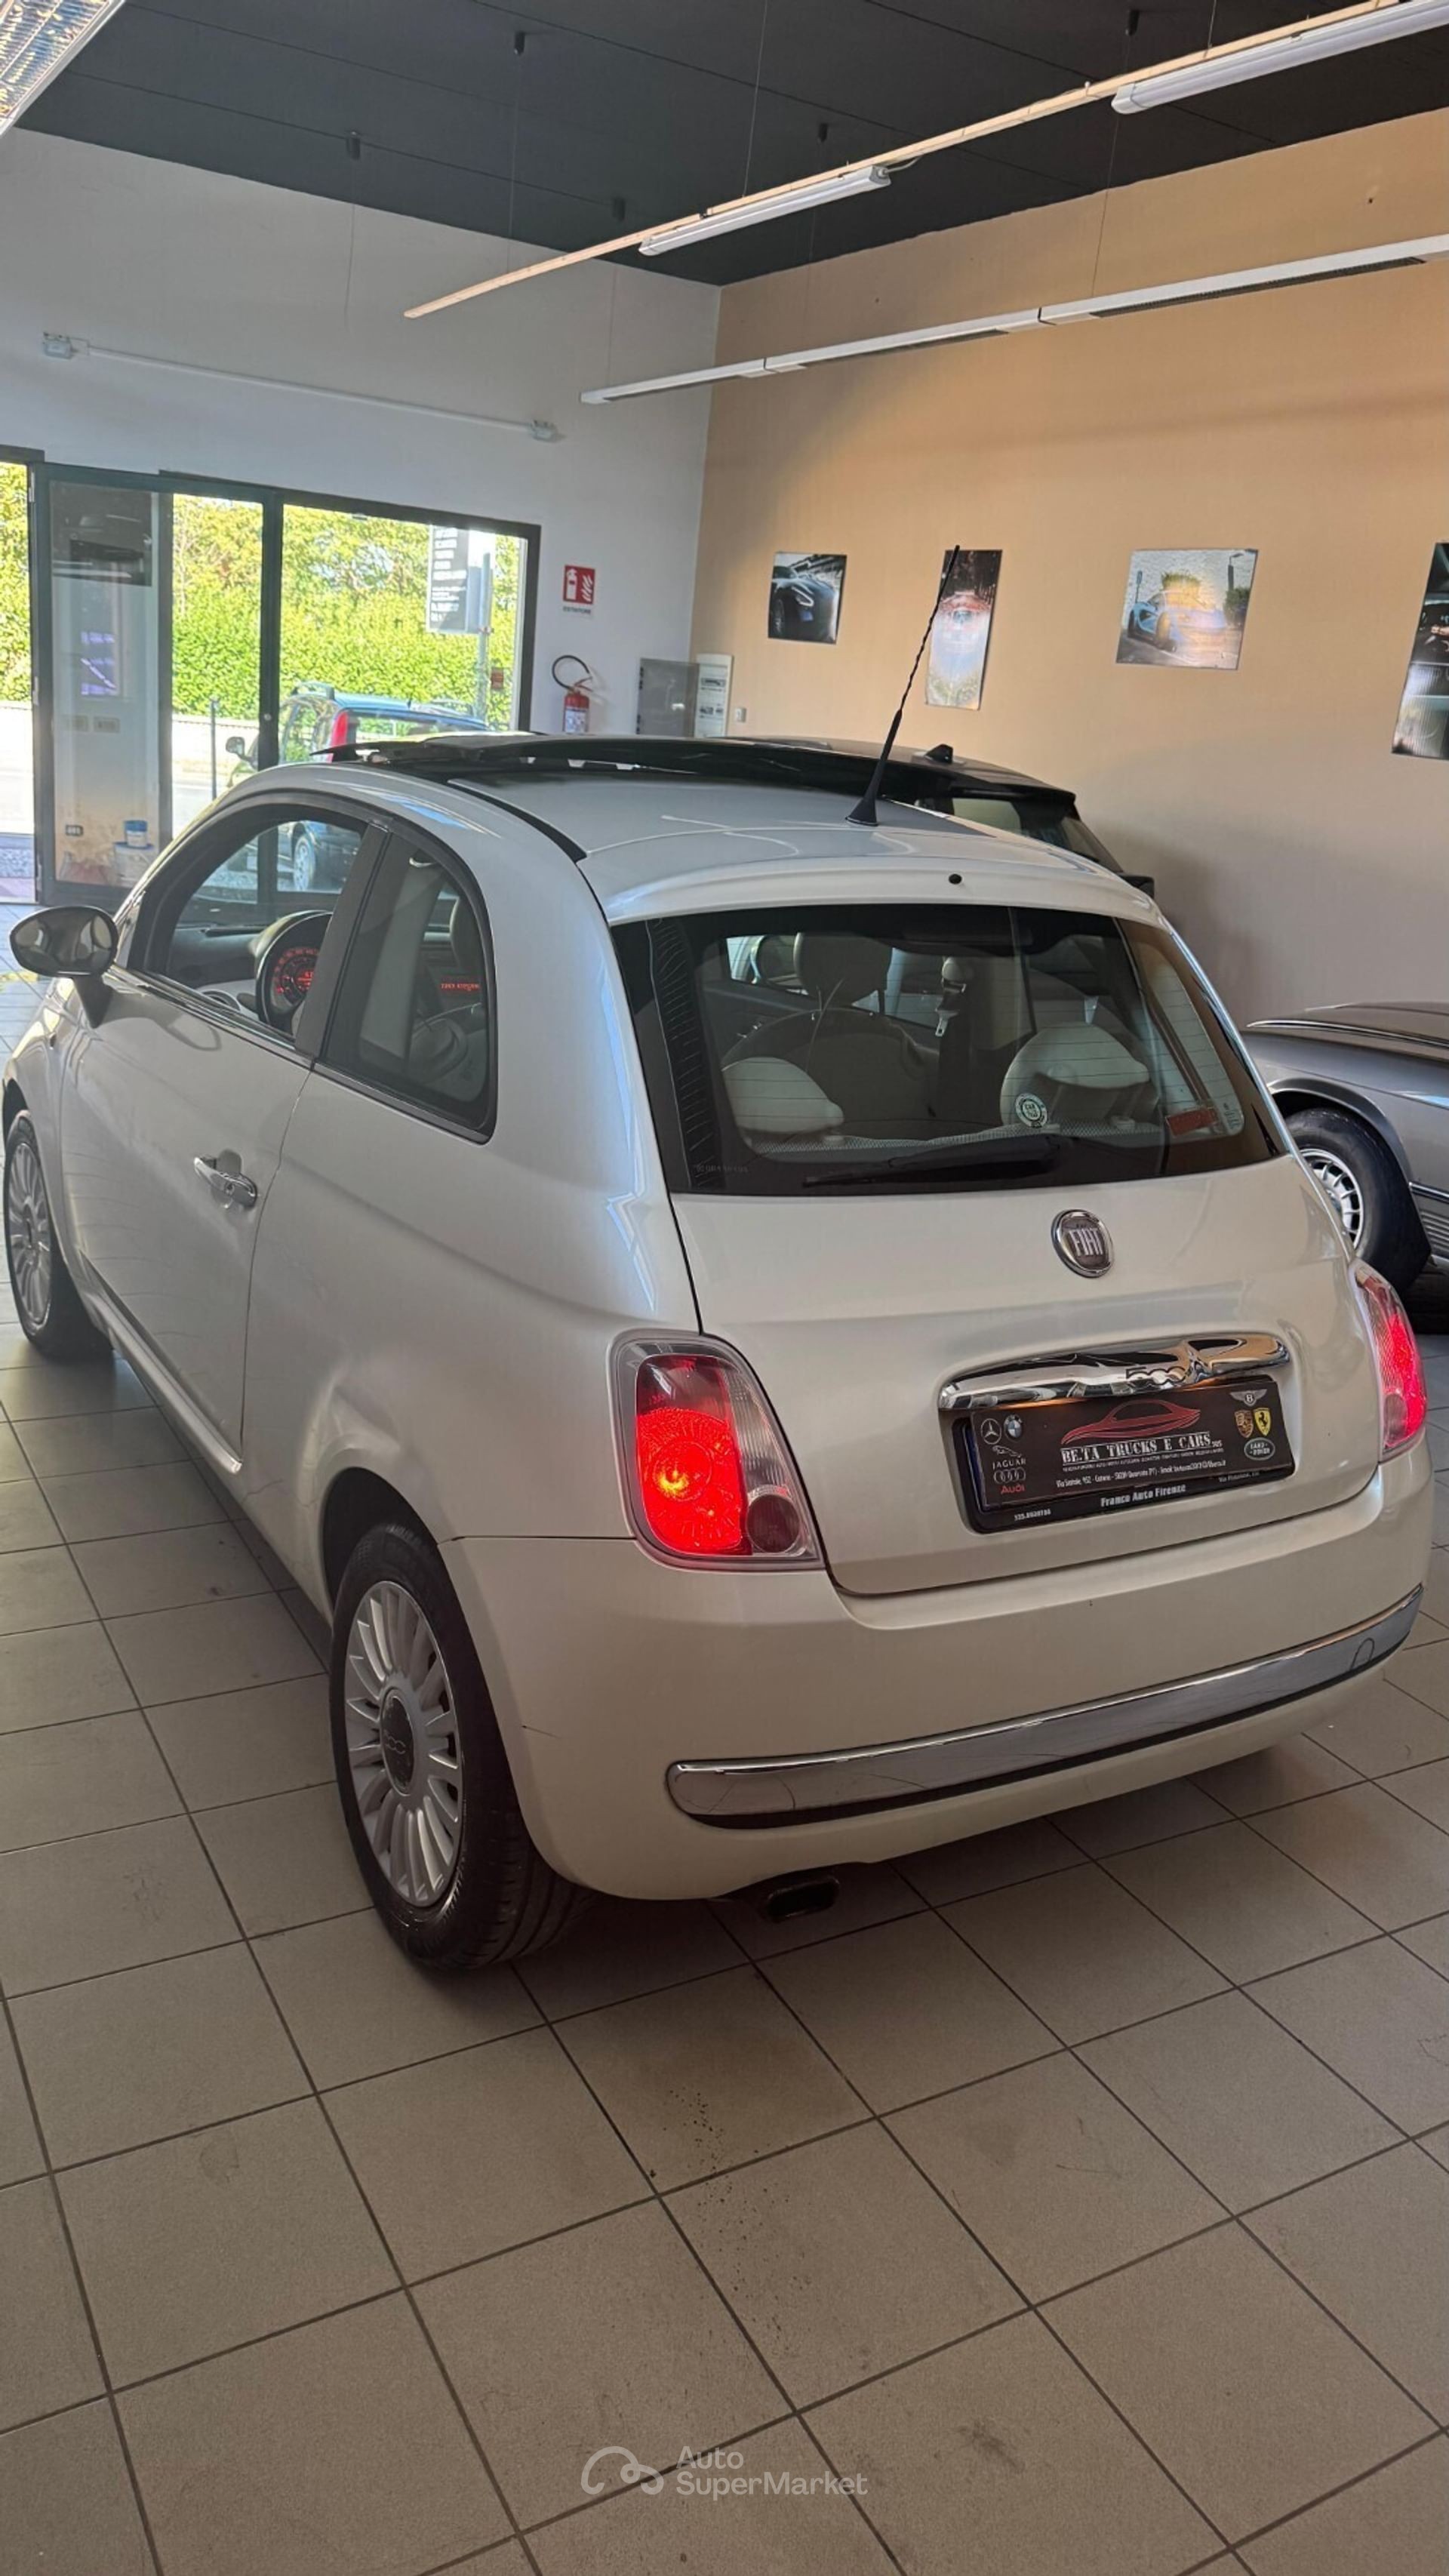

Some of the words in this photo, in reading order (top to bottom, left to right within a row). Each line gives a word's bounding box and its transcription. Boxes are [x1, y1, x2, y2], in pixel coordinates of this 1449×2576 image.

[1069, 1227, 1103, 1256] FIAT
[1106, 1439, 1158, 1458] TRUCKS
[1163, 1438, 1173, 1451] E
[992, 1457, 1026, 1470] JAGUAR
[1132, 1490, 1154, 1502] Auto
[1155, 1484, 1186, 1497] Firenze
